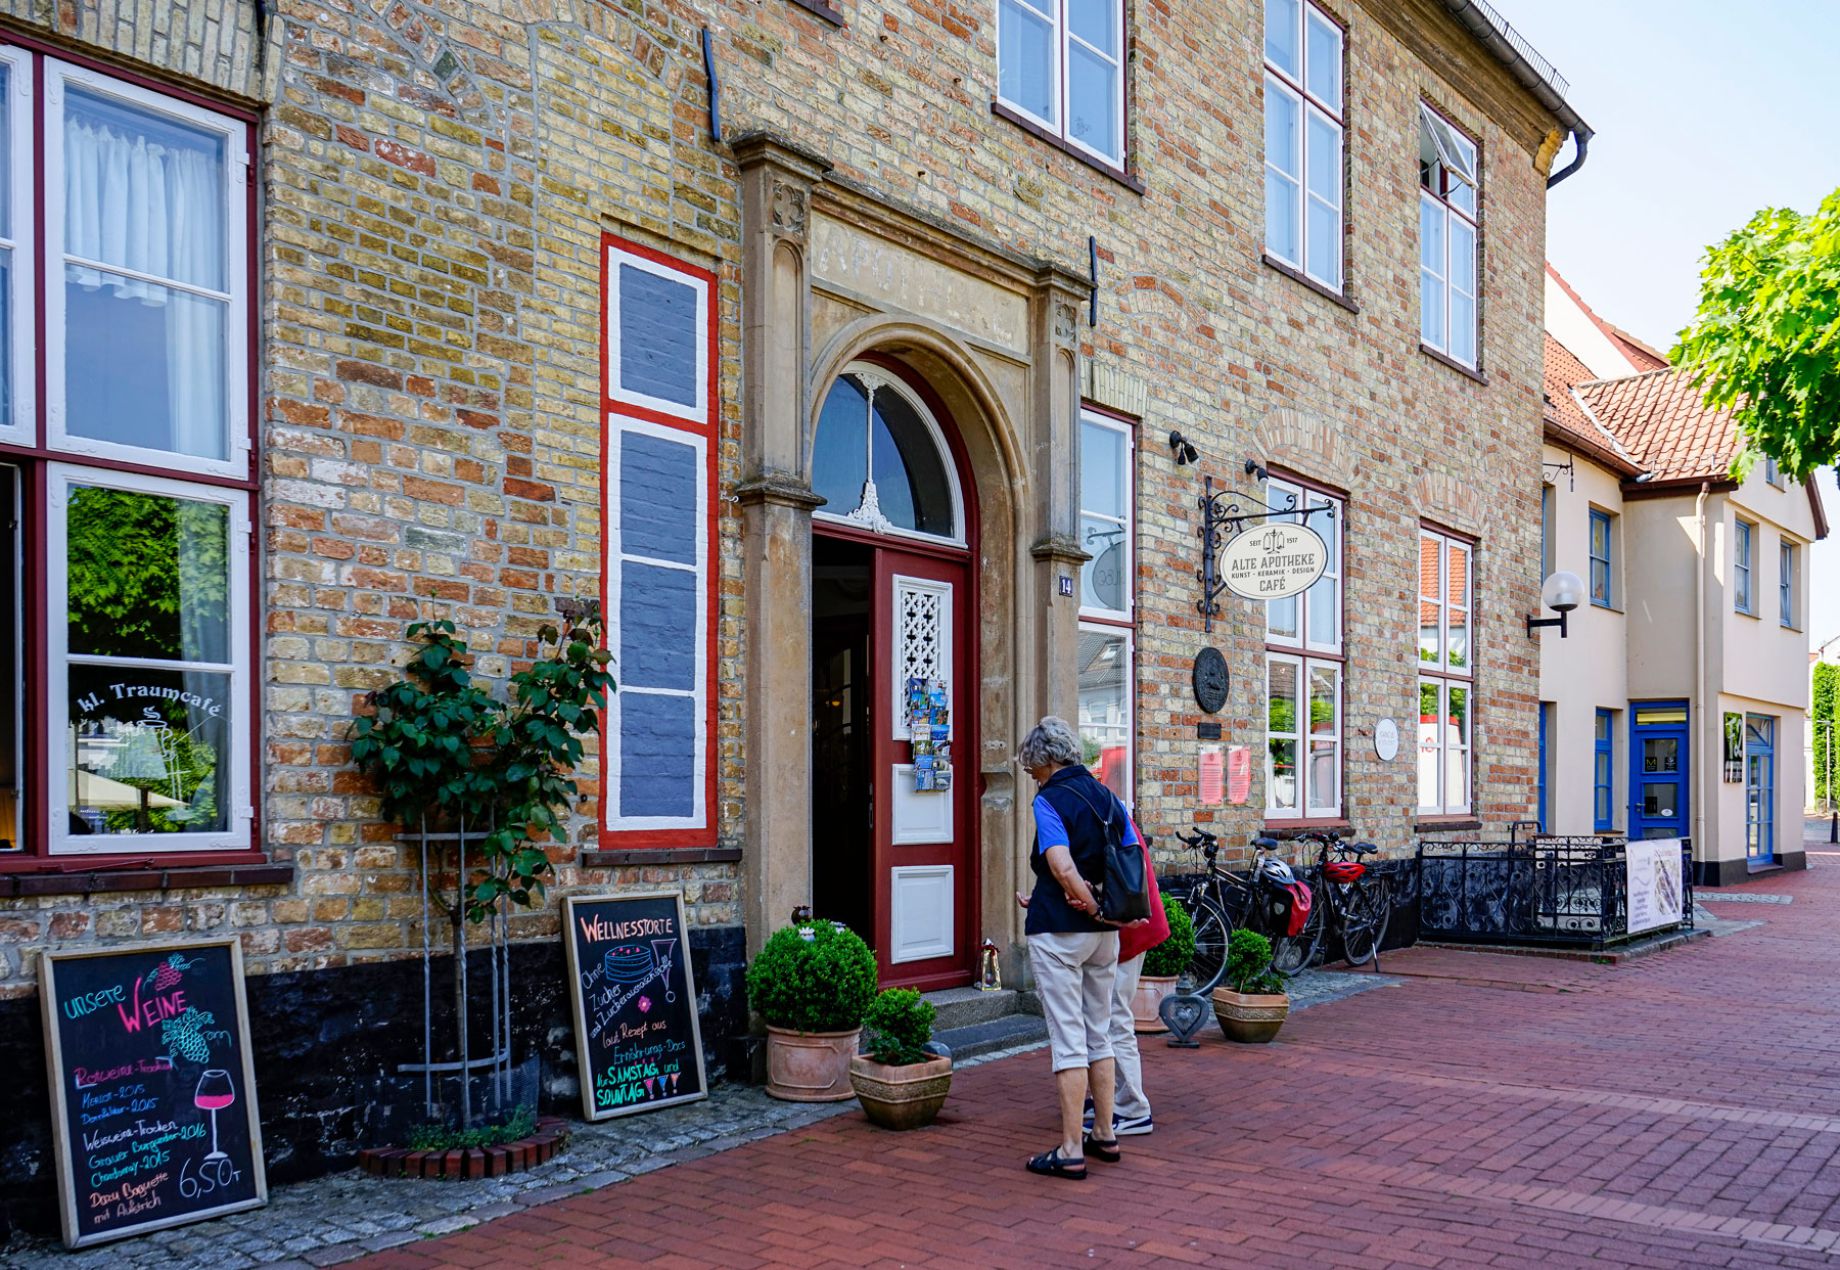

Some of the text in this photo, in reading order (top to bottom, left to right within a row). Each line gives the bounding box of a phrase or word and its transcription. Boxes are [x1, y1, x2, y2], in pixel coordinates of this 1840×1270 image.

[1231, 554, 1315, 571] ALTE APOTHEKE
[1292, 567, 1315, 575] DESIGN
[1061, 578, 1072, 594] 14
[1260, 576, 1286, 592] CAFÉ
[110, 683, 222, 716] Traumcafé
[580, 913, 674, 944] WELLNESSTORTE
[117, 976, 188, 1033] WEINE
[589, 982, 622, 1012] Zucker
[620, 1022, 648, 1040] Rezept
[652, 1020, 668, 1031] aus
[664, 1058, 680, 1073] und
[596, 1082, 645, 1107] SONNTAG
[88, 1150, 129, 1169] Grauer
[122, 1172, 170, 1200] Baguette
[94, 1190, 162, 1224] mit Aufstrich
